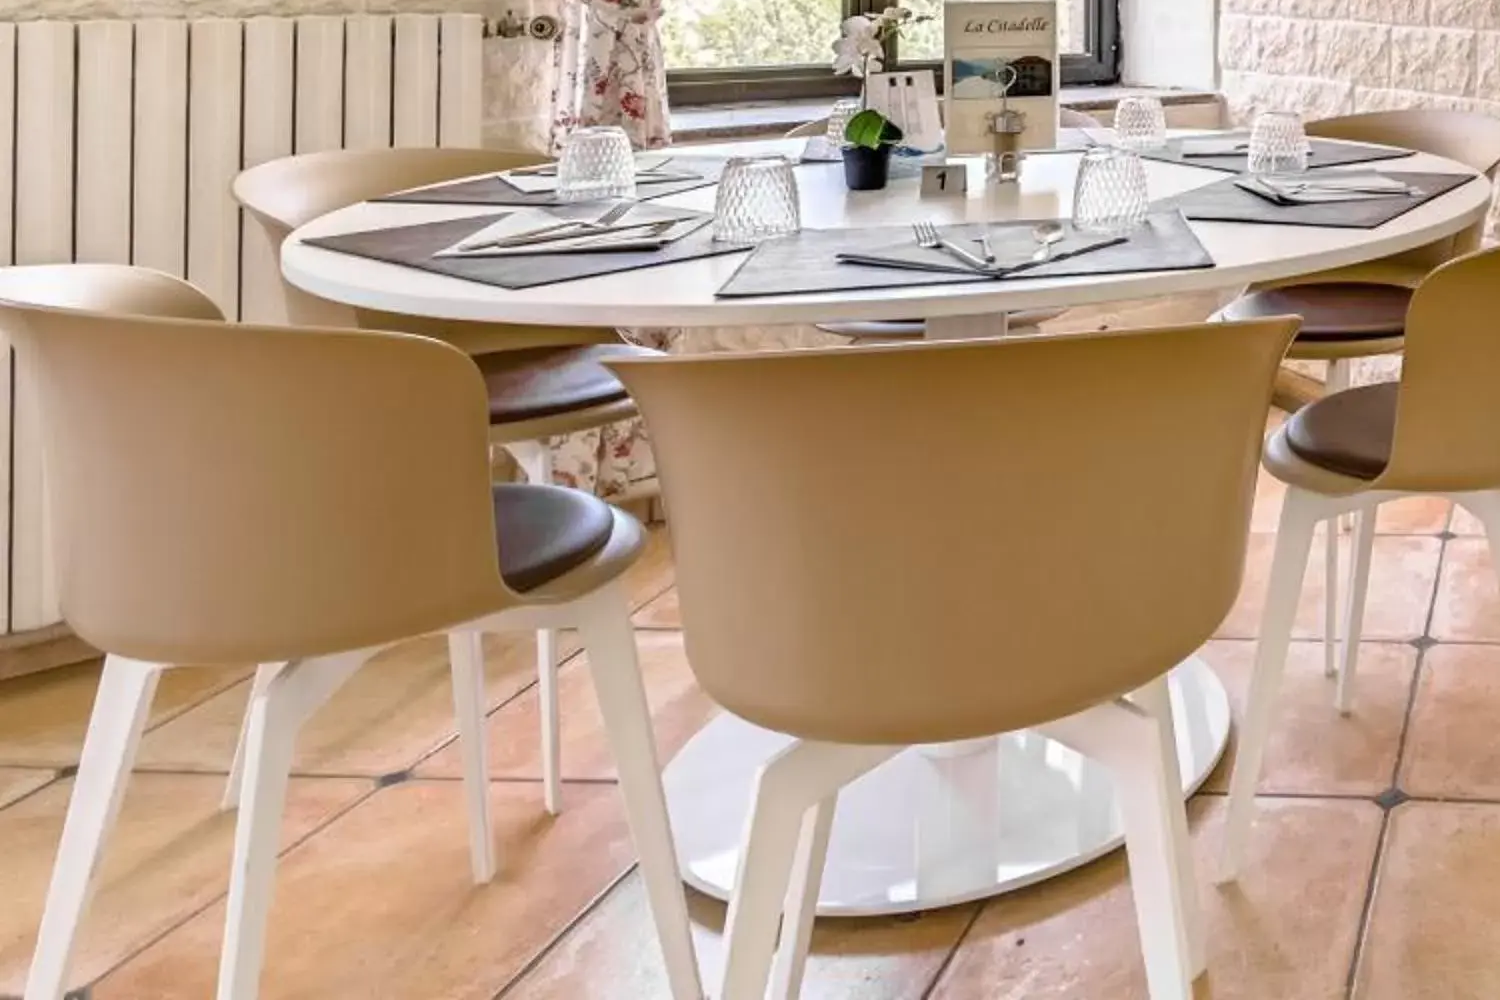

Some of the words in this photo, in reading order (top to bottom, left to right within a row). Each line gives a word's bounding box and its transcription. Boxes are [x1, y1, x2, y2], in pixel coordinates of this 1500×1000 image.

[963, 19, 983, 33] La
[987, 16, 1050, 34] Citadelle
[936, 170, 947, 191] 1
